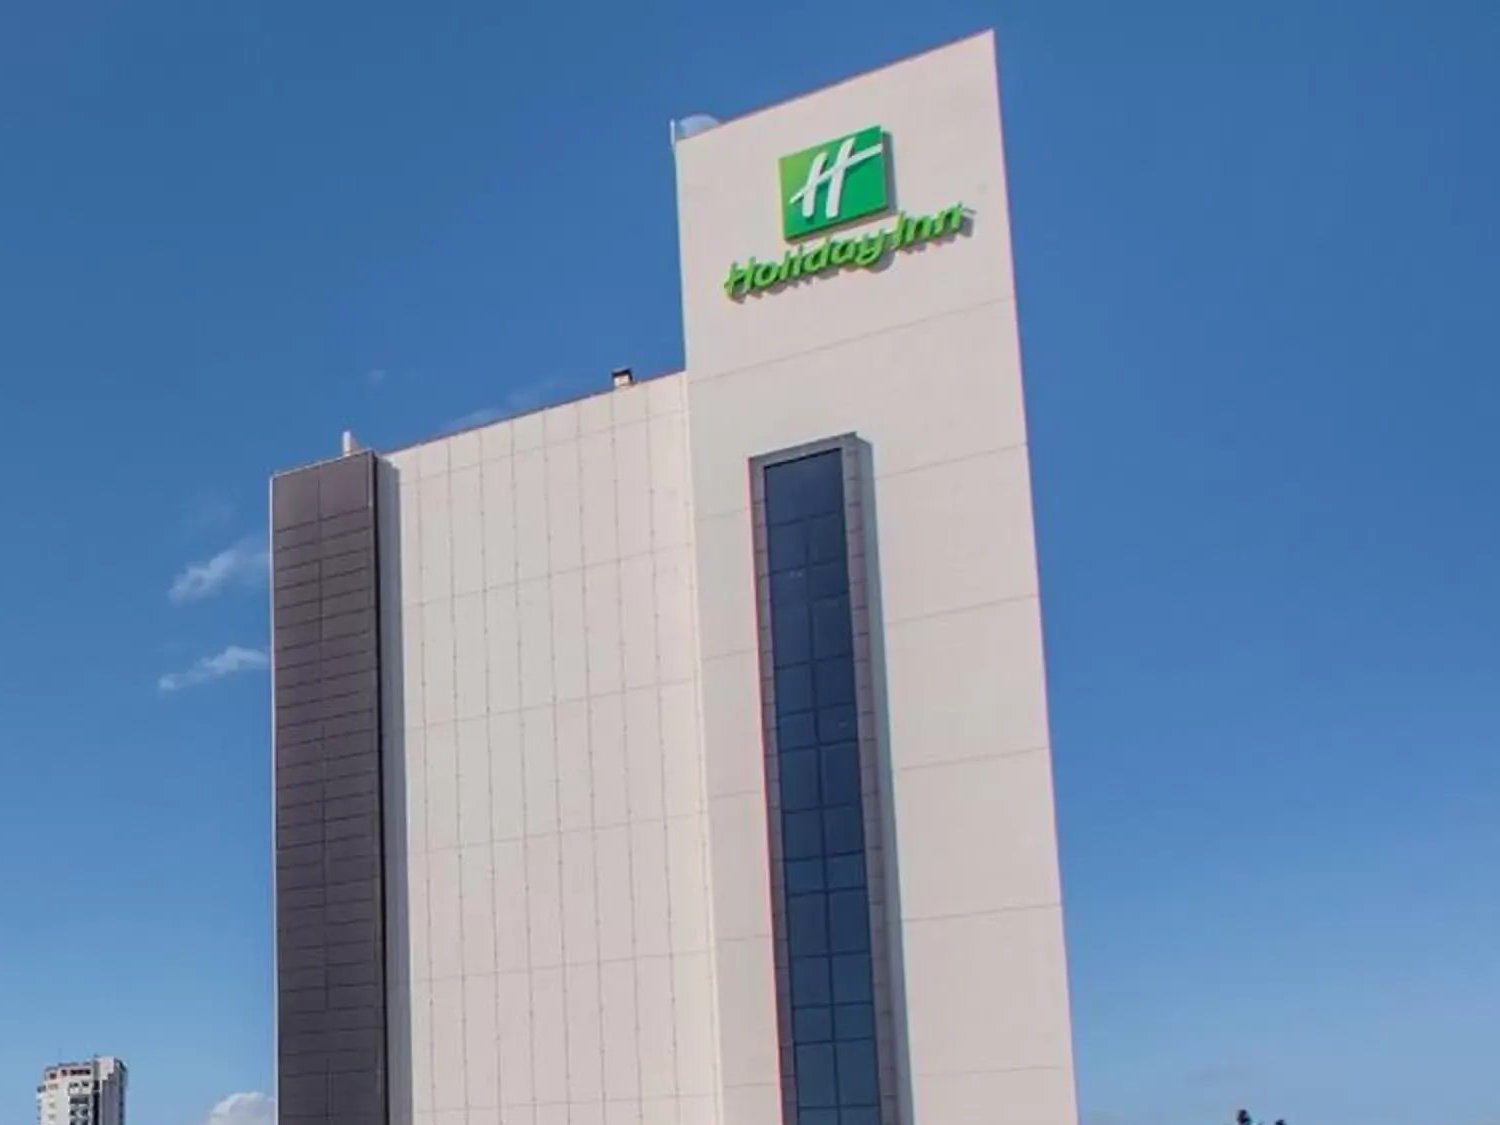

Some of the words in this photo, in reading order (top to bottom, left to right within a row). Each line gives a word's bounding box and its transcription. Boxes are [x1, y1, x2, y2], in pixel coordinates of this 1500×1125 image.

[789, 137, 884, 218] H
[724, 229, 887, 298] Holiday
[891, 202, 965, 249] Inn
